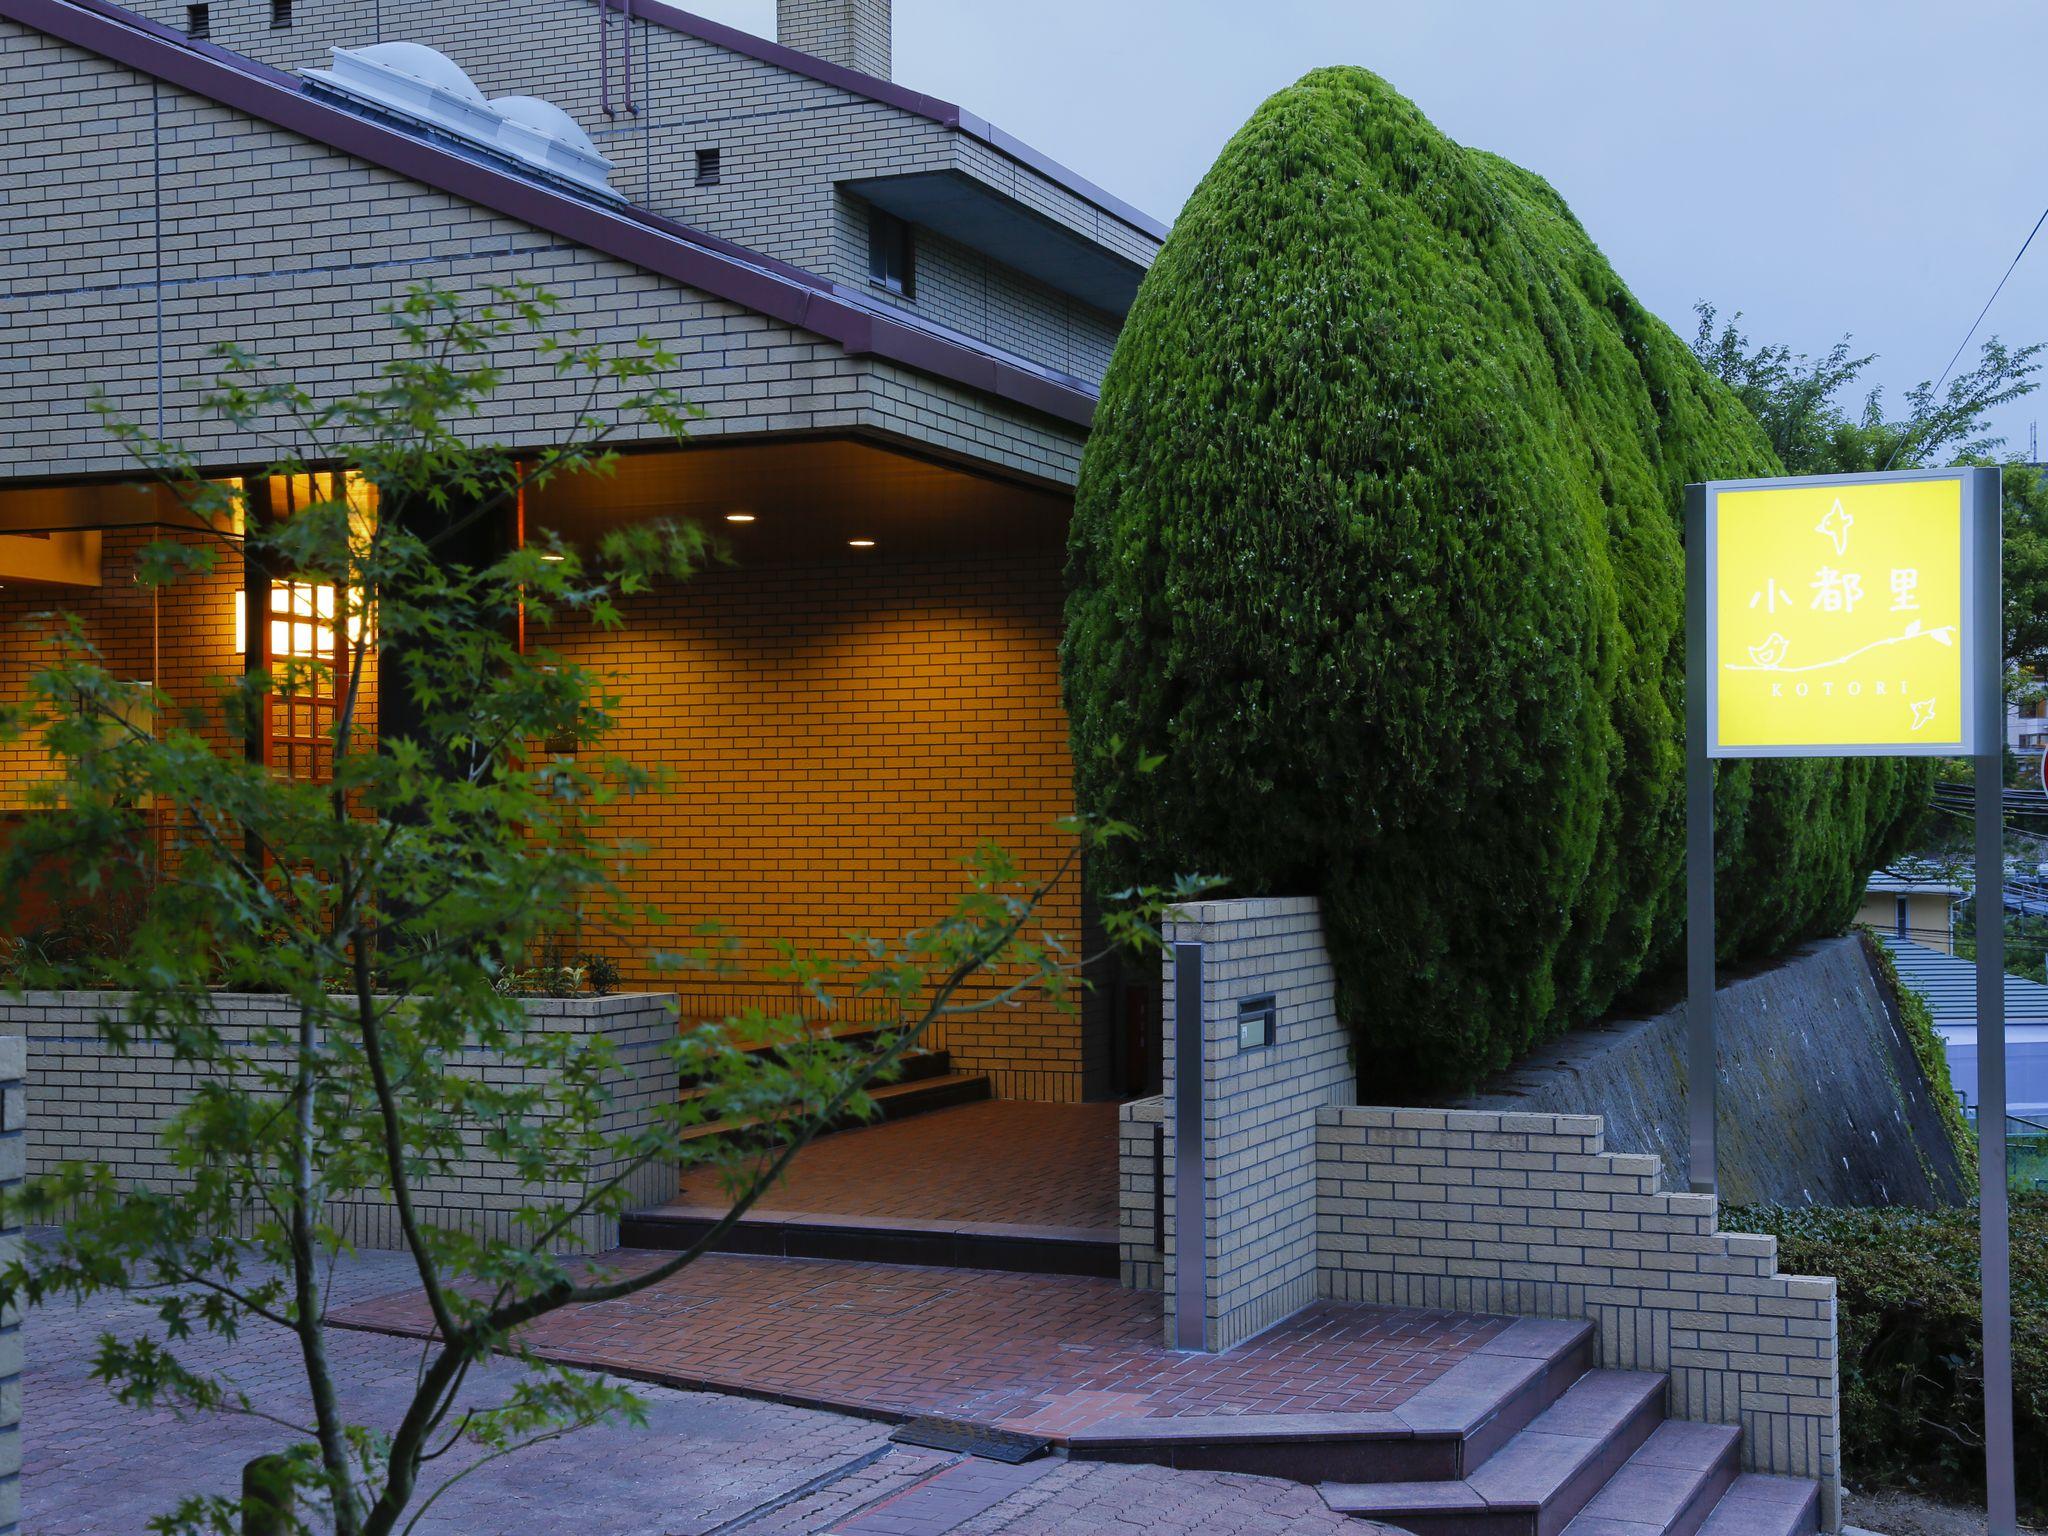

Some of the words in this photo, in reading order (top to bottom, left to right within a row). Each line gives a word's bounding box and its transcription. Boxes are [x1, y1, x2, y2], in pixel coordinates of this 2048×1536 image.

[1750, 566, 1920, 612] 小都里
[1772, 681, 1908, 696] KOTORI
